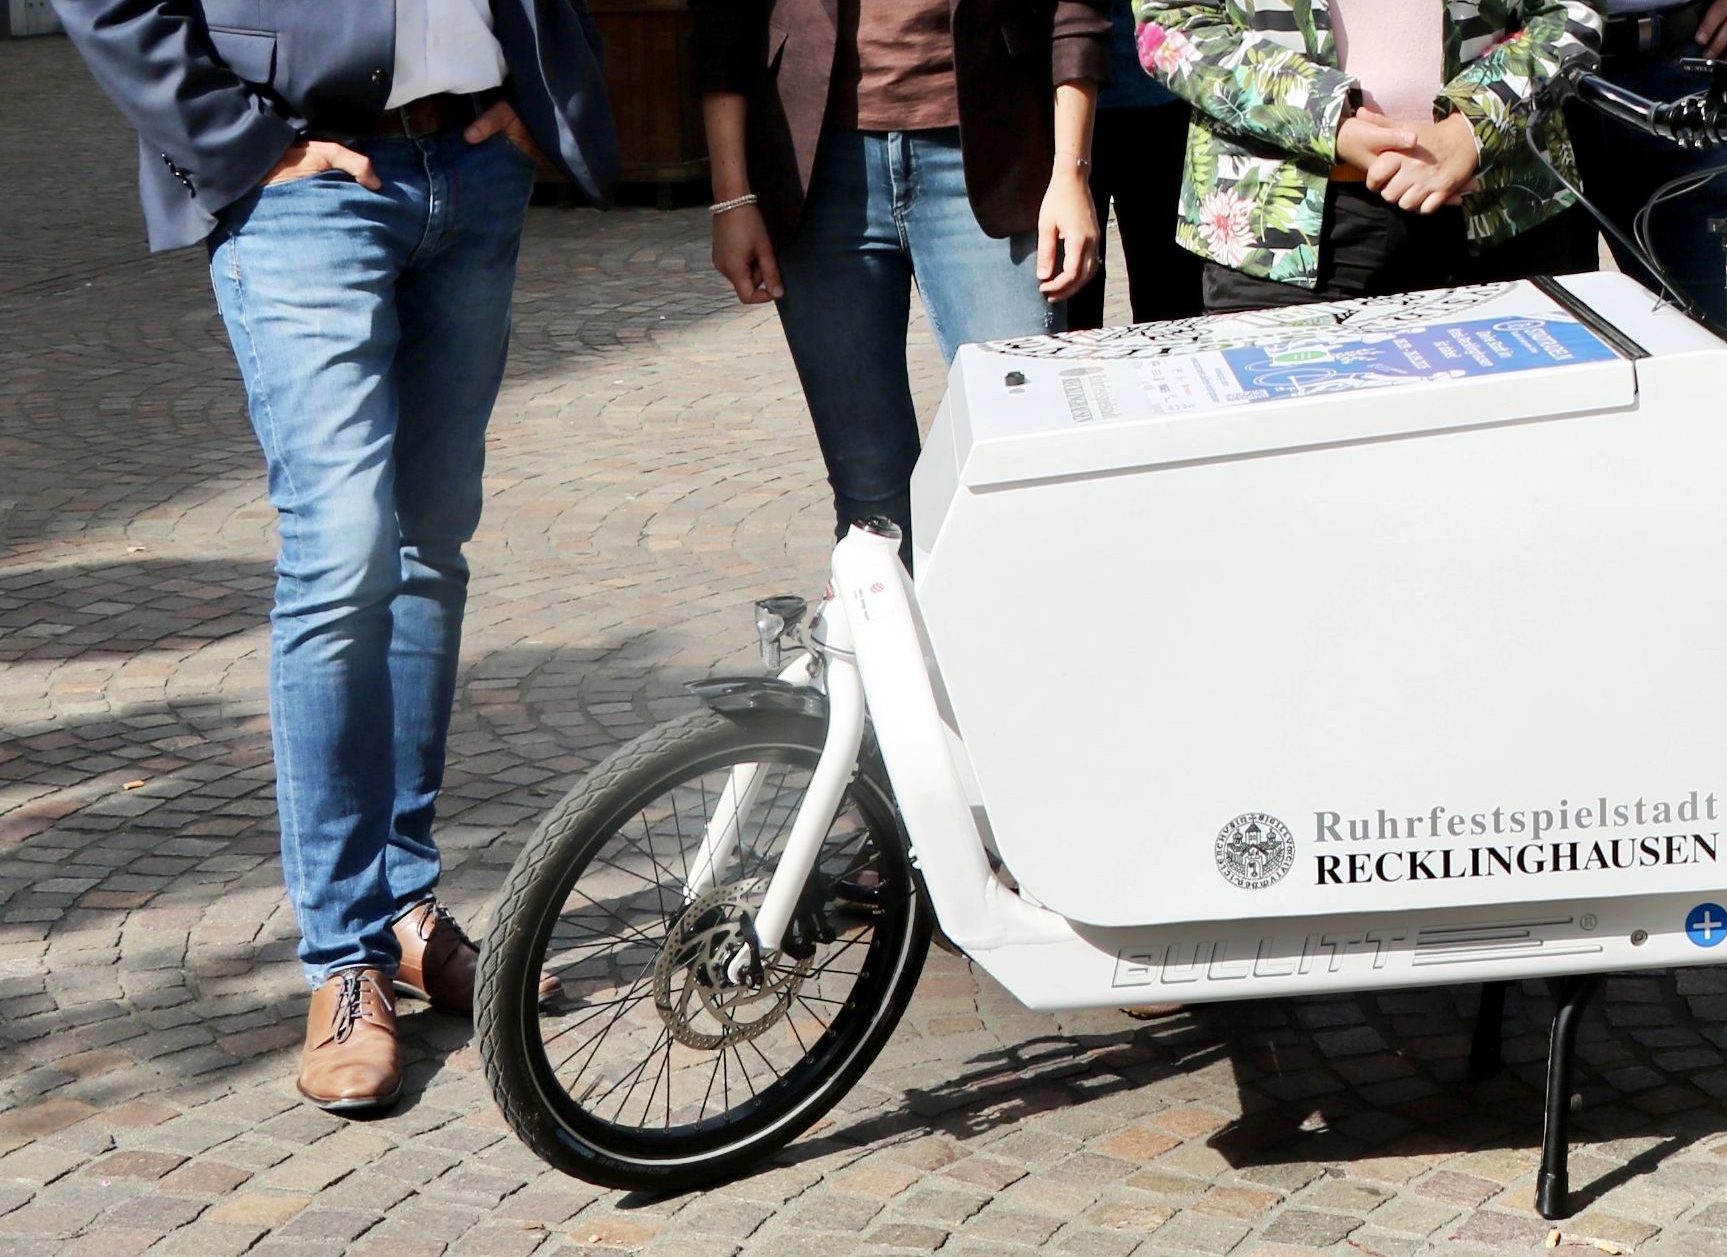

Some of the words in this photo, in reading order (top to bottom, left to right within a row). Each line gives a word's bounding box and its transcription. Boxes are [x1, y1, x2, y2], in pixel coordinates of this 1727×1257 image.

[1313, 791, 1719, 843] Ruhrfestspielstadt
[1313, 832, 1719, 885] RECKLINGHAUSEN
[1111, 927, 1410, 989] BULLITT
